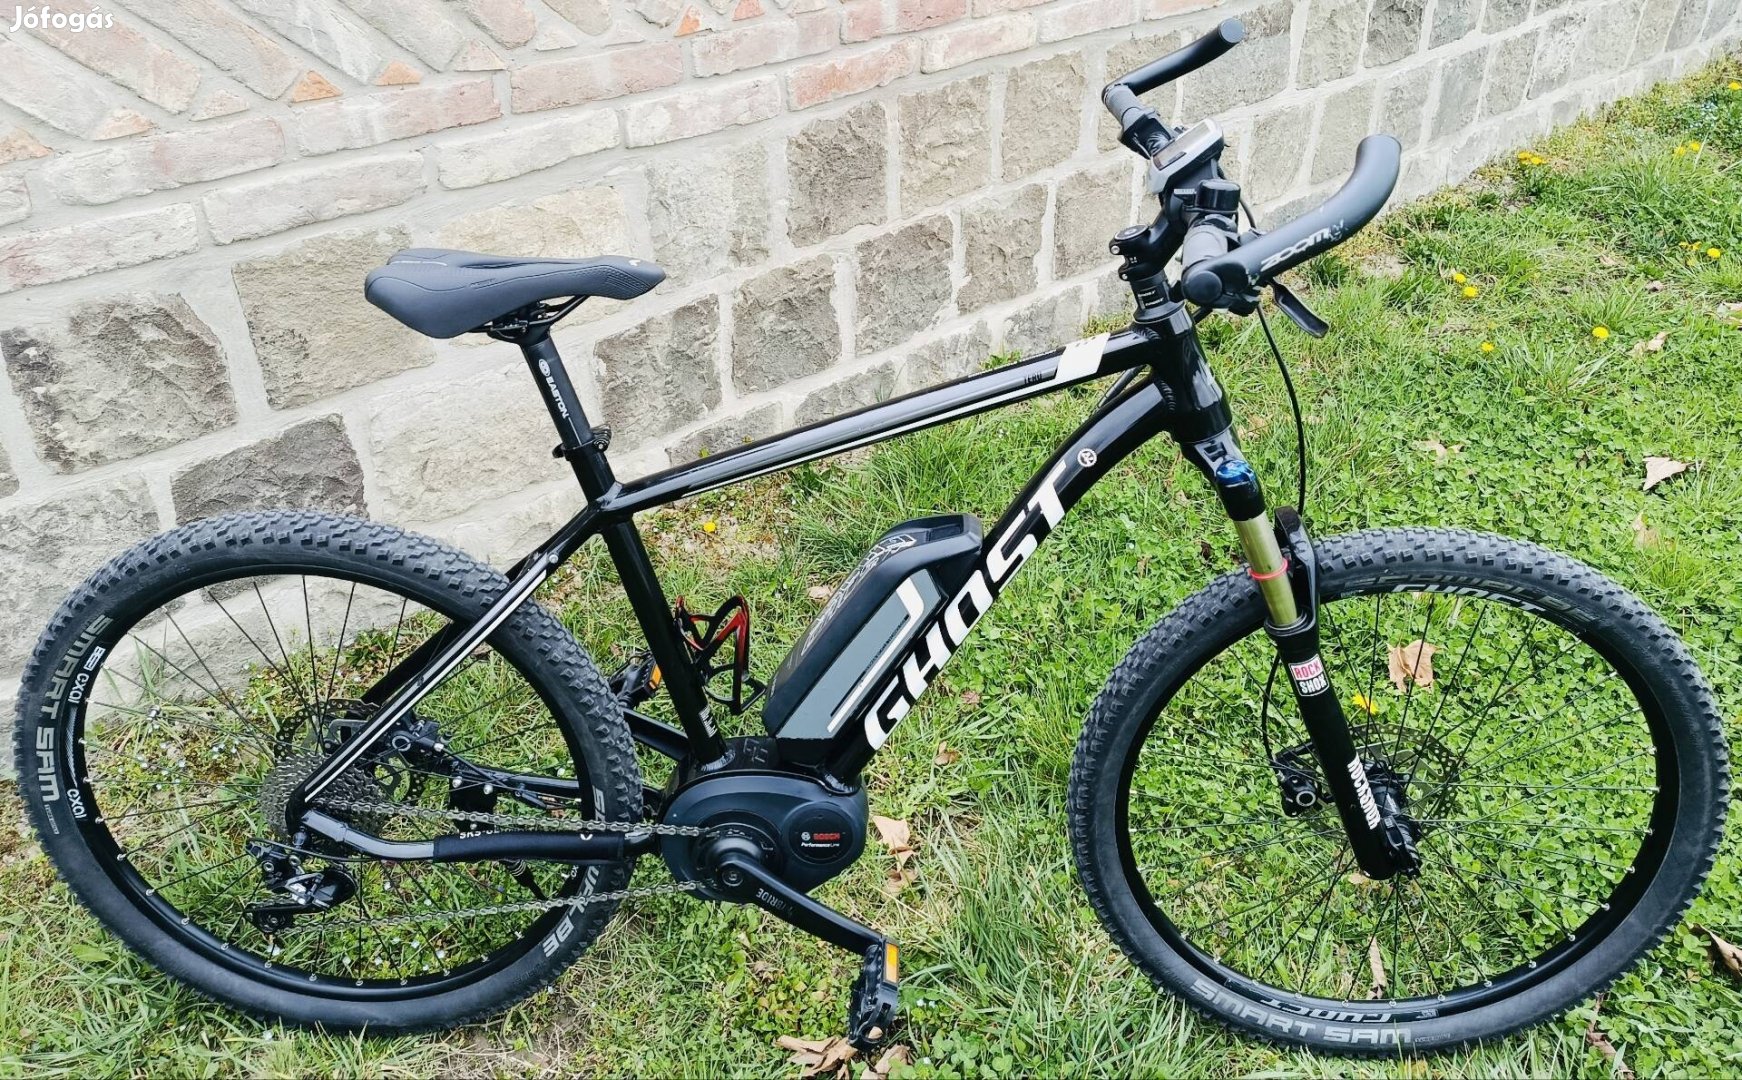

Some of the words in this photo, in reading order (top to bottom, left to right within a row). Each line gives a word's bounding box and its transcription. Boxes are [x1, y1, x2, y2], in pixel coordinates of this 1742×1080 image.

[546, 376, 570, 419] EASTON
[864, 459, 1067, 751] GHOST
[41, 614, 115, 720] SMART
[1293, 662, 1323, 680] ROCK
[1299, 674, 1328, 694] SHOX
[35, 726, 60, 802] SAM
[1190, 978, 1317, 1038] SMART
[1323, 1026, 1412, 1045] SAM
